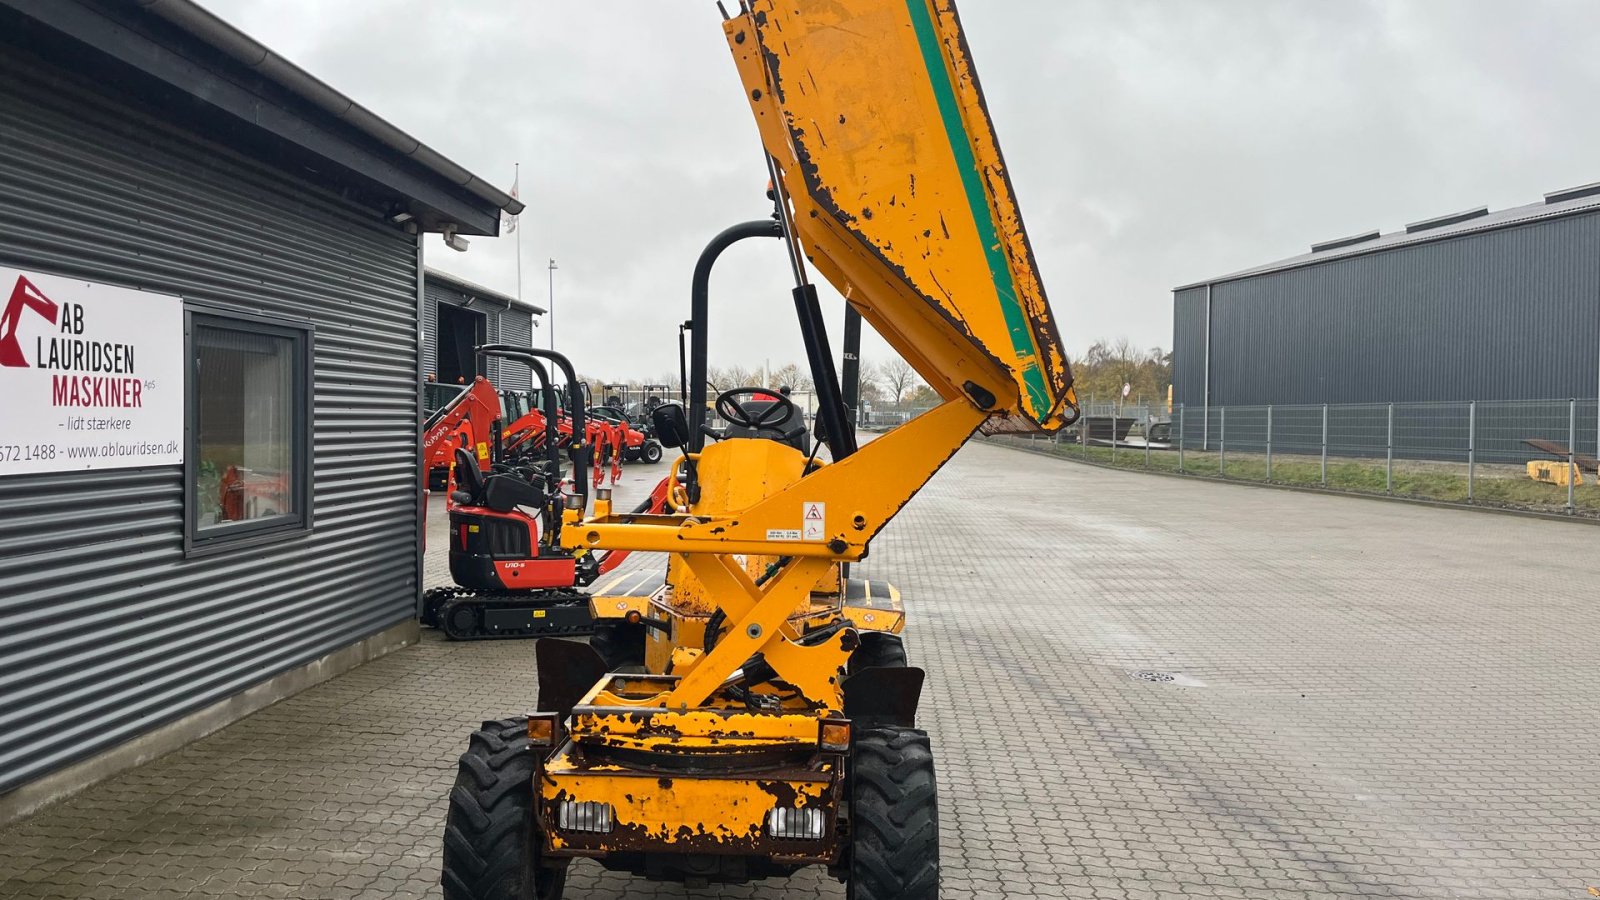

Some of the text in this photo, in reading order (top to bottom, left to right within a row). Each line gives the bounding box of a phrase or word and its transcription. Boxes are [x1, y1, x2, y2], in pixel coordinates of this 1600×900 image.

[61, 302, 85, 335] AB
[37, 336, 135, 374] LAURIDSEN
[52, 374, 142, 408] MASKINER
[67, 416, 85, 431] lidt
[86, 418, 132, 431] stærkere
[24, 444, 56, 461] 1488
[67, 441, 179, 459] www.ablauridsen.dk
